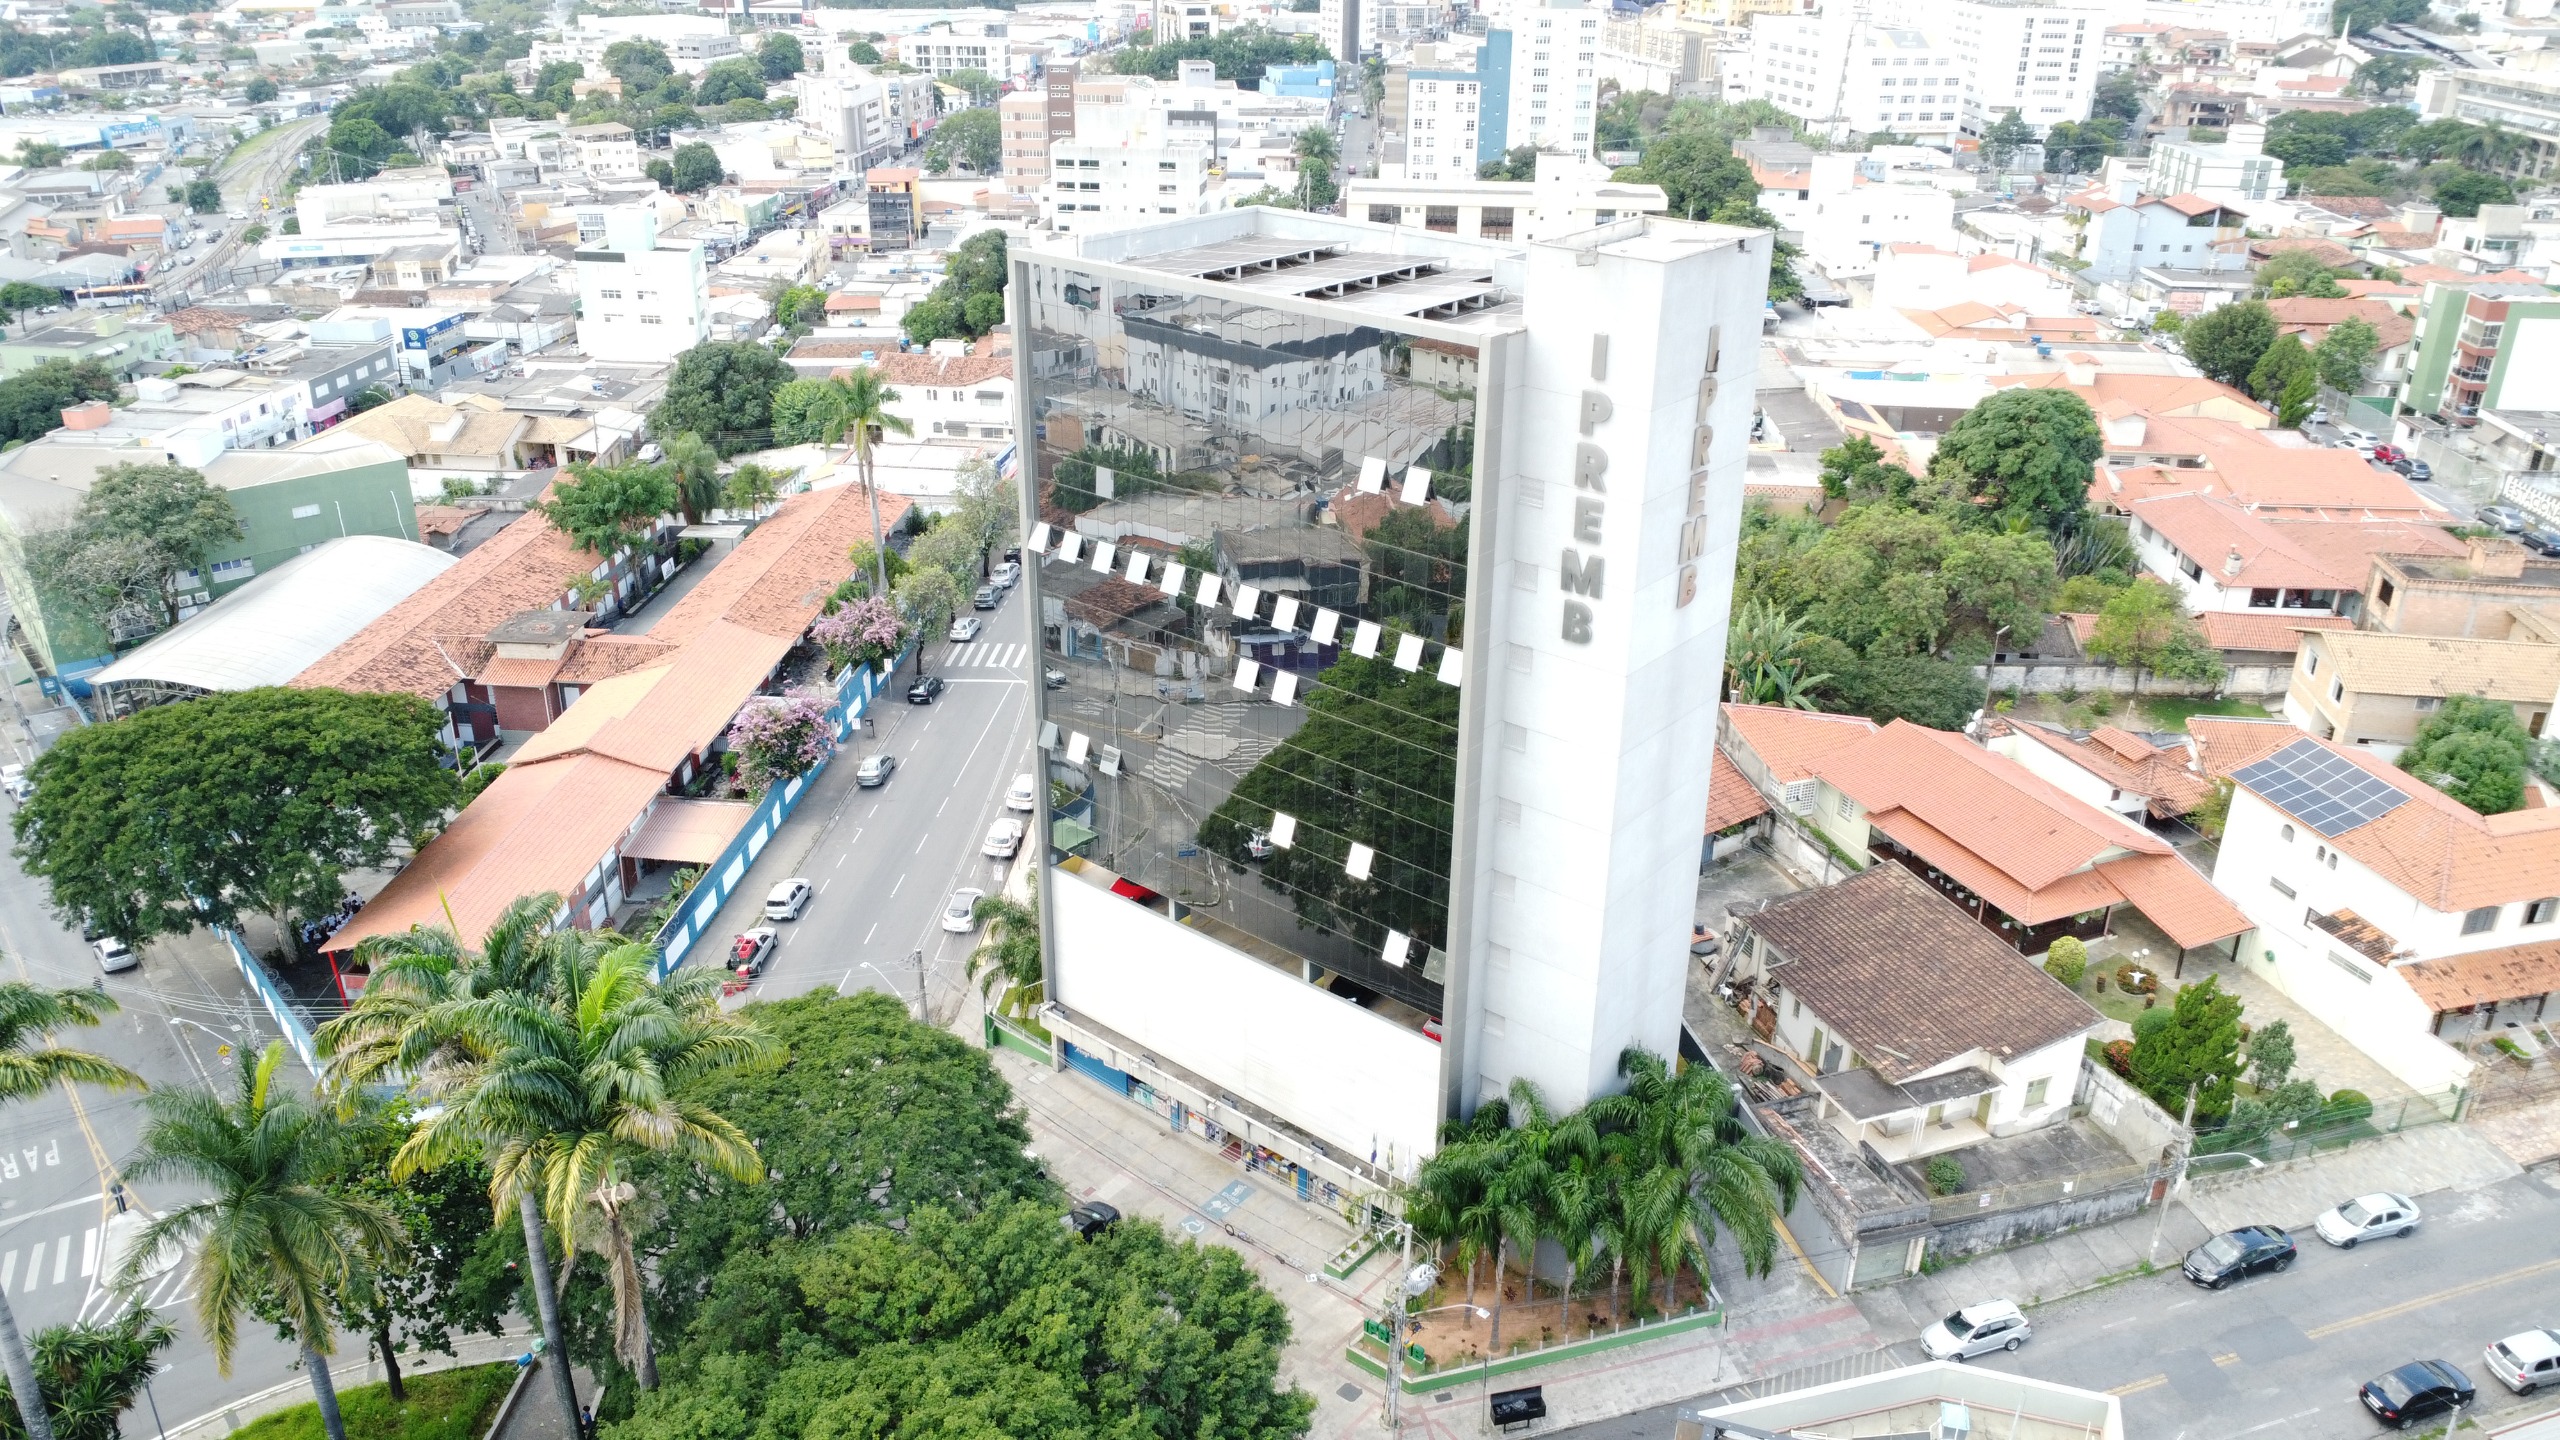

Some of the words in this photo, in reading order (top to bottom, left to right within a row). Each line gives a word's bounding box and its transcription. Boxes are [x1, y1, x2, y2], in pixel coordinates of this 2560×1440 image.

[1560, 332, 1613, 644] IPREMB
[1676, 325, 1721, 609] IPREMB
[0, 1139, 61, 1184] PAR
[1363, 1317, 1425, 1361] IPRB
